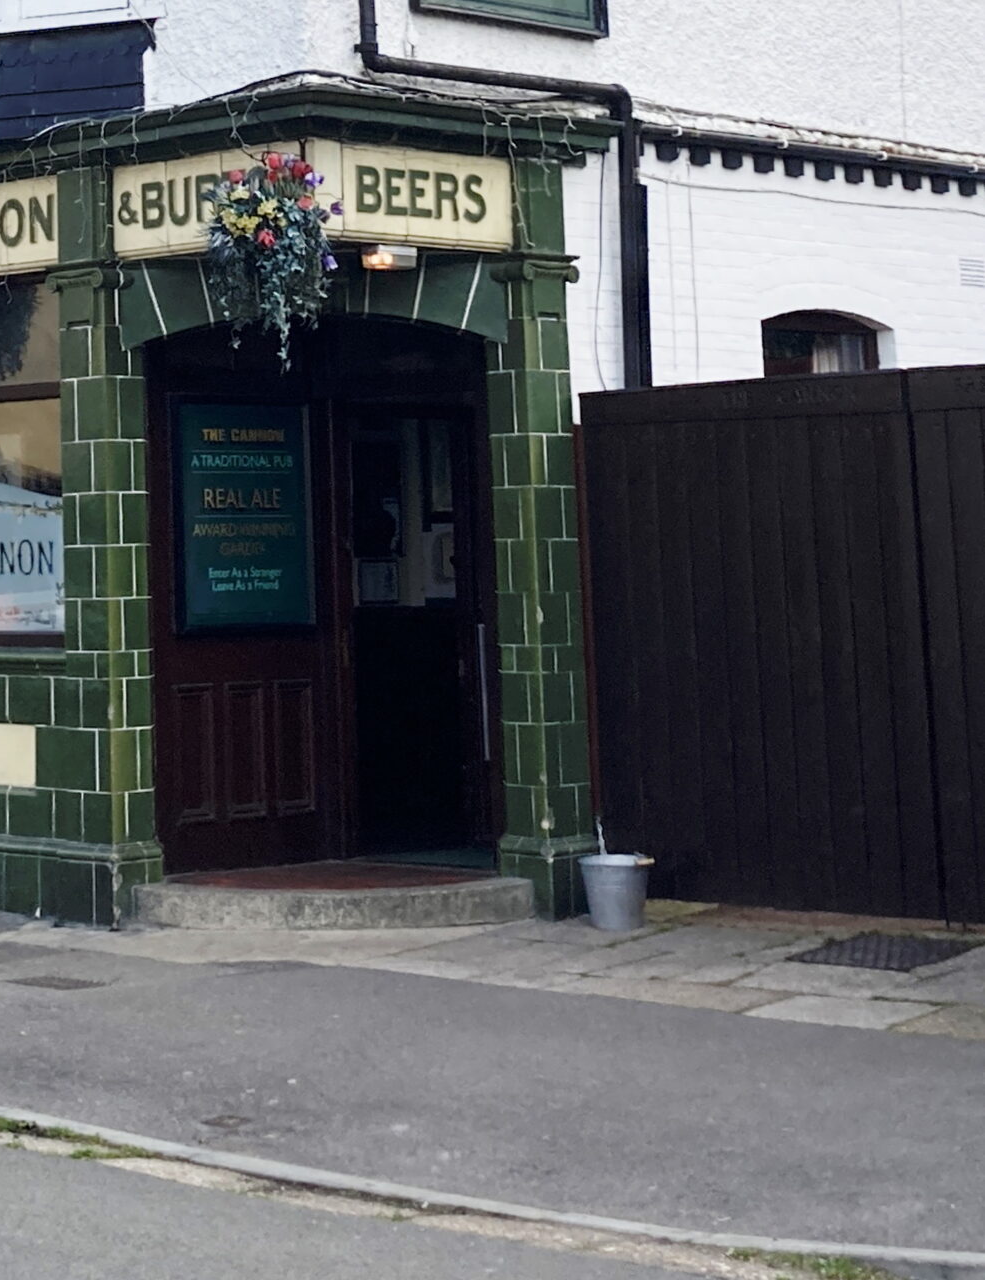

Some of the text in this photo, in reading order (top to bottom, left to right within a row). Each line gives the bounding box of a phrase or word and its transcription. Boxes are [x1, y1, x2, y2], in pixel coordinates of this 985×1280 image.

[355, 164, 488, 223] BEERS
[202, 427, 226, 443] THE
[190, 454, 294, 469] A TRADITIONAL PUB
[203, 487, 282, 510] REAL ALE
[192, 522, 237, 537] AWARD
